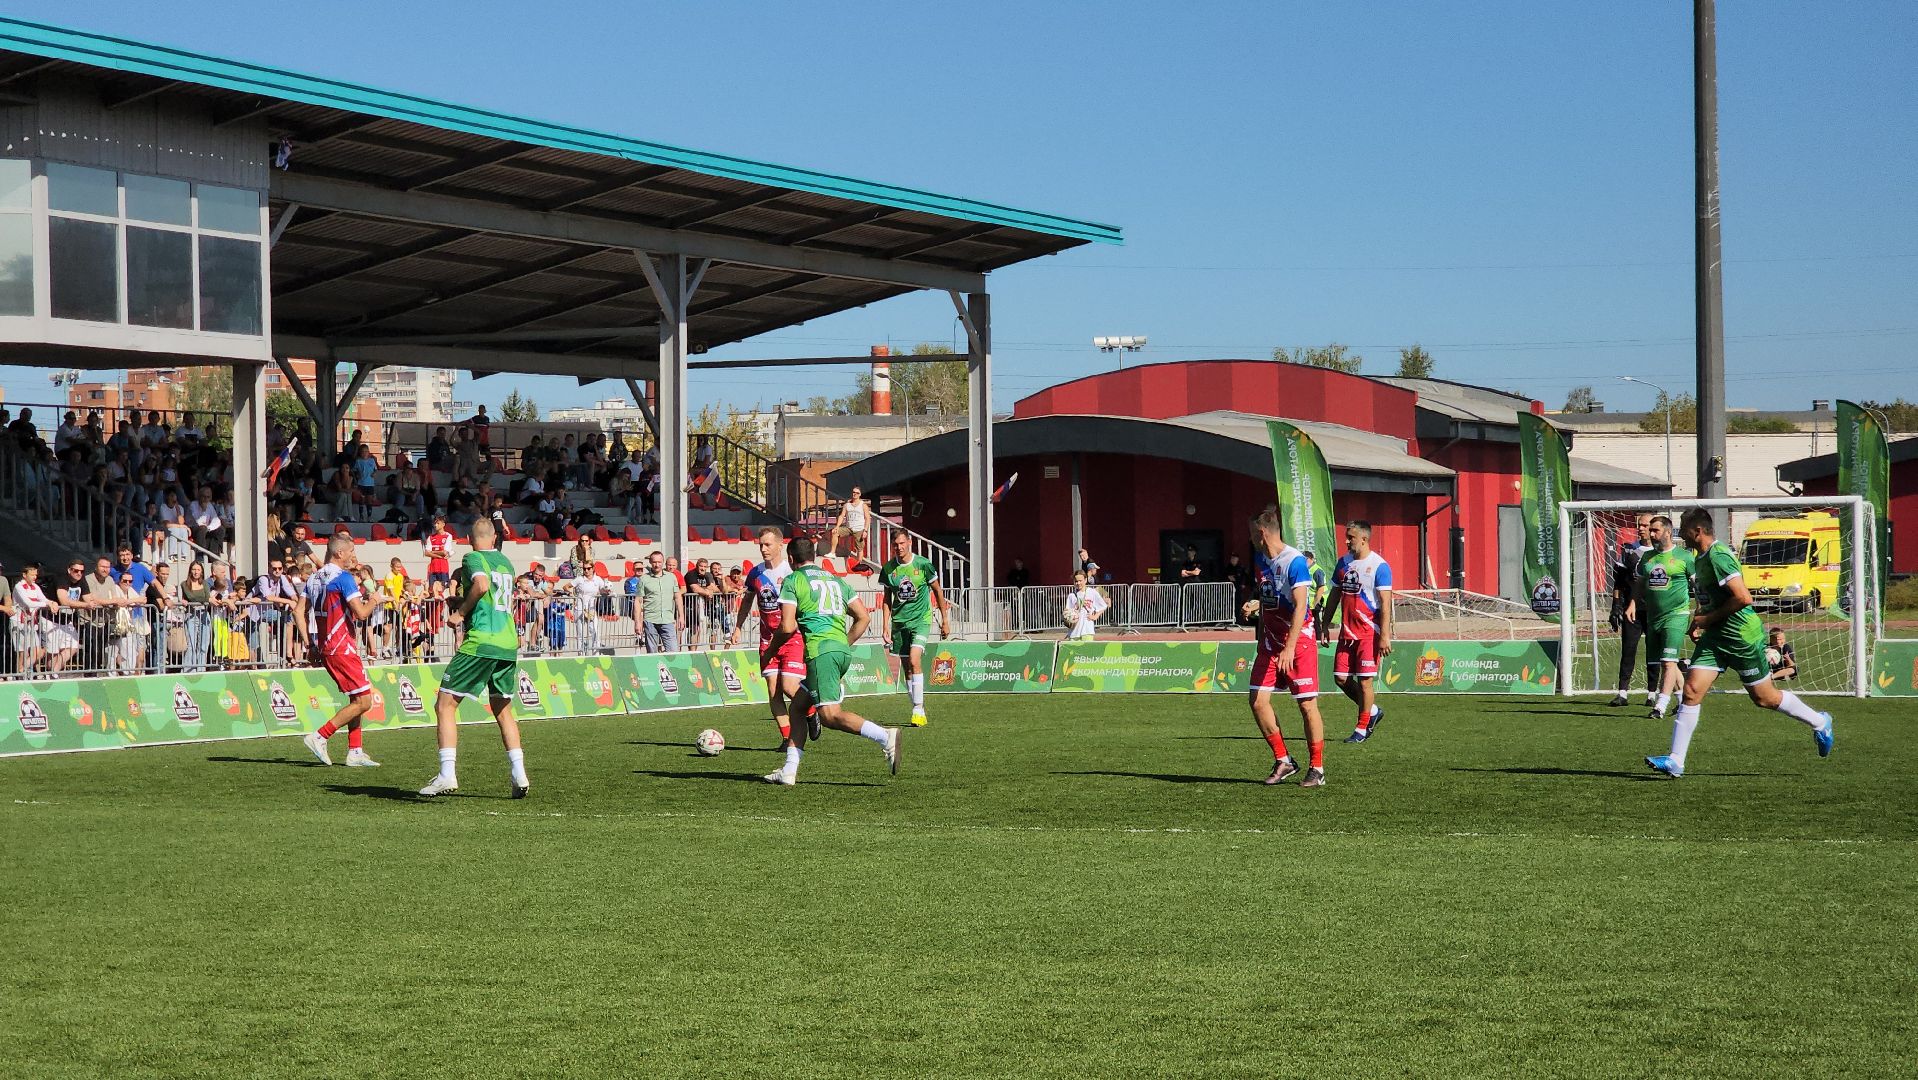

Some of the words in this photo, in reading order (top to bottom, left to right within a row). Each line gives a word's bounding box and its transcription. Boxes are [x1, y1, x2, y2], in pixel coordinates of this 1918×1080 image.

[810, 579, 842, 615] 20
[963, 658, 1004, 670] Команда
[1074, 656, 1162, 665] #ВЫХОДИВОДВОР
[1451, 658, 1500, 670] Команда
[961, 671, 1021, 682] Губернатора
[1071, 668, 1193, 677] #КОМАНДАГУБЕРНАТОРА
[1450, 672, 1520, 683] Губернатора
